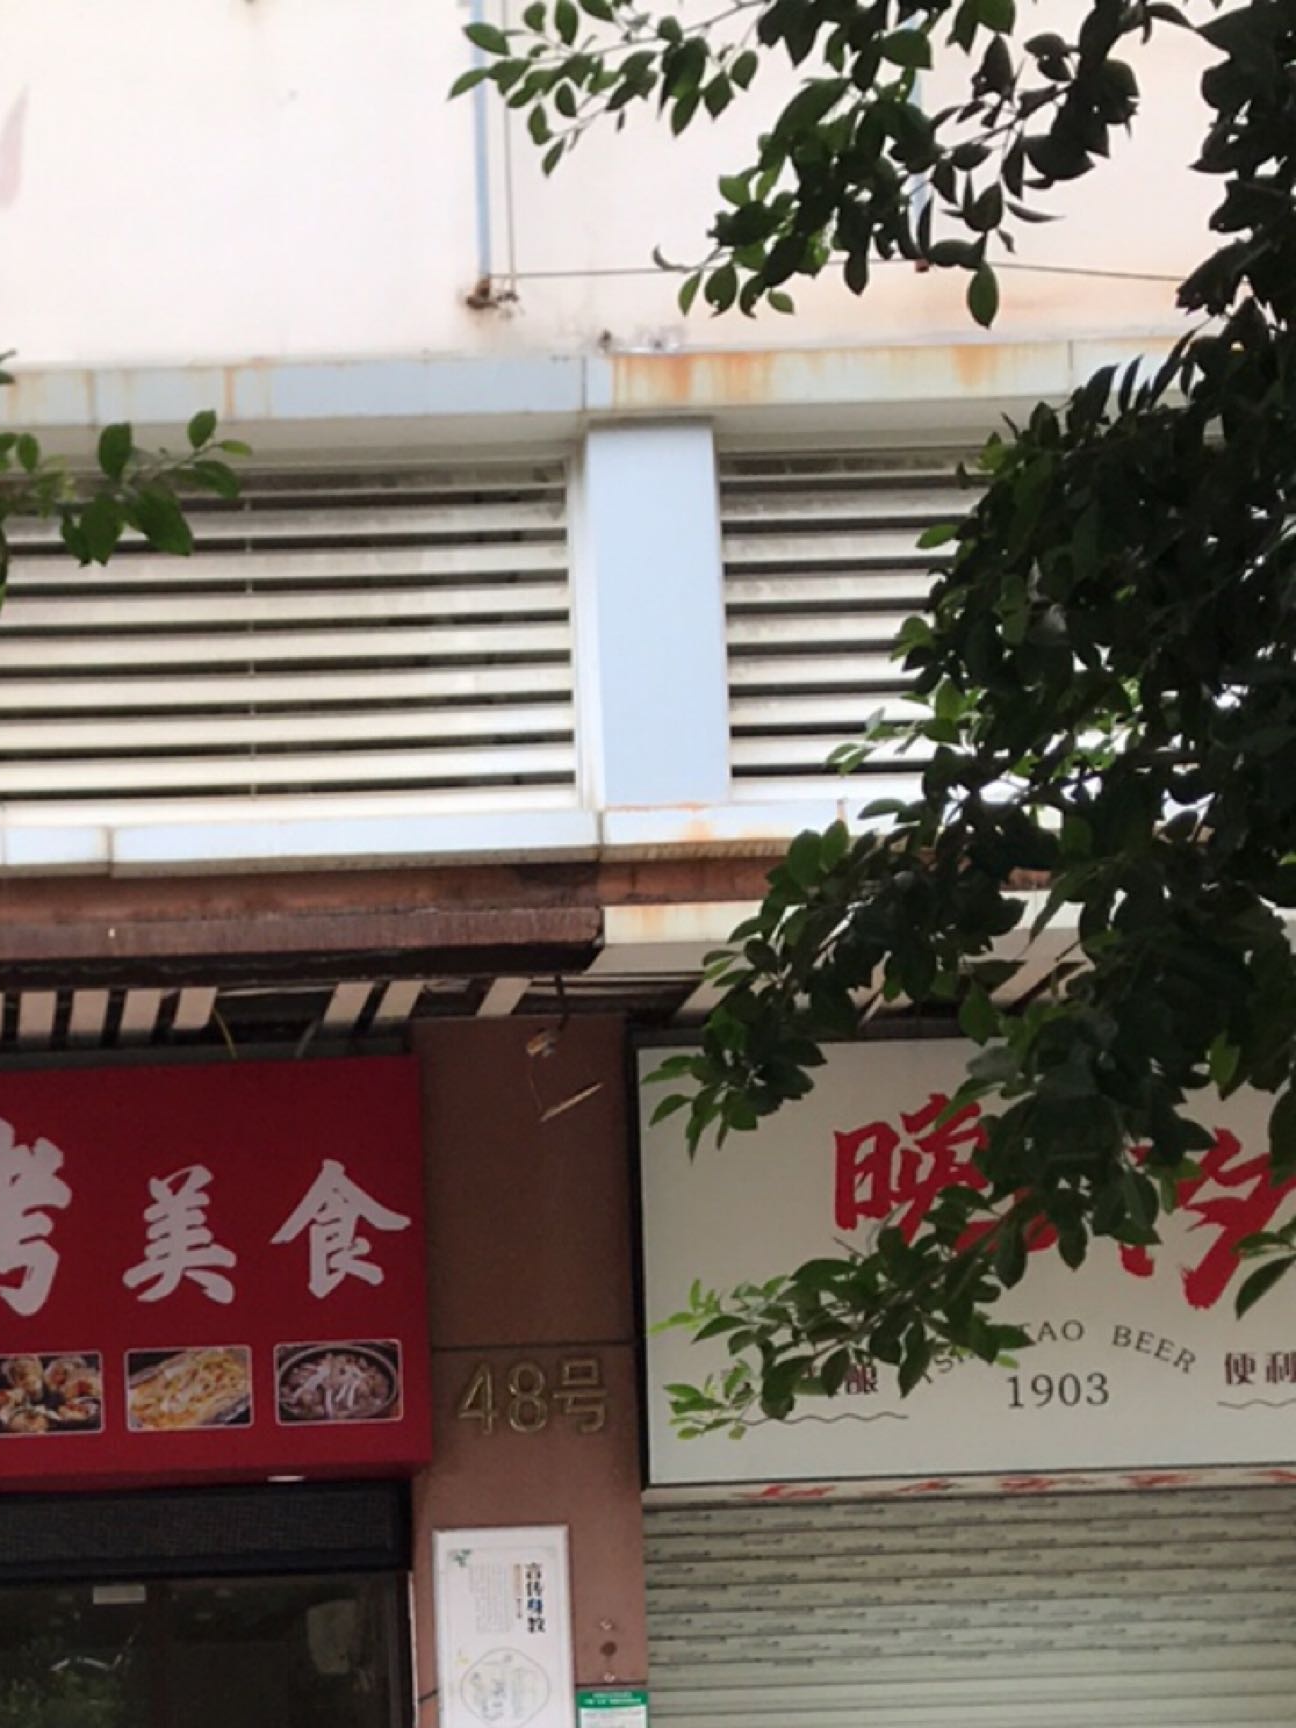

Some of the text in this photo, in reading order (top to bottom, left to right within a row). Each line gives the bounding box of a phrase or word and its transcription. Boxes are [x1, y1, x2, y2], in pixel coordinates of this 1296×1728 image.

[1112, 1325, 1197, 1374] BEER
[459, 1358, 607, 1434] 48号
[1008, 1373, 1109, 1409] 1903
